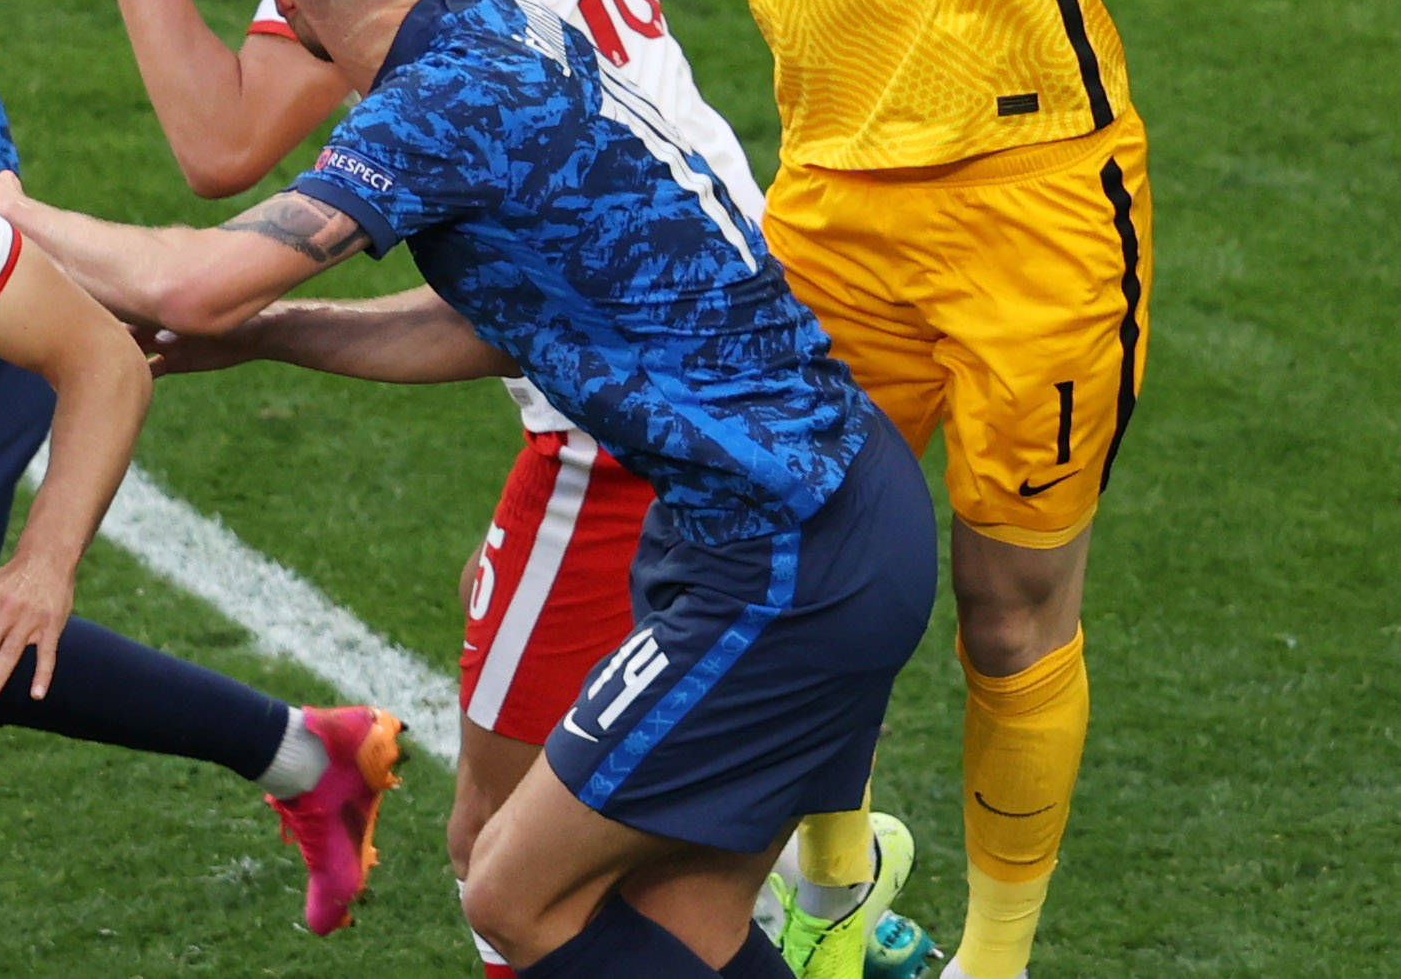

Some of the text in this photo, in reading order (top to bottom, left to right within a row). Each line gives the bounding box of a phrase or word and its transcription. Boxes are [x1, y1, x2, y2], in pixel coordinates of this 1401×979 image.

[328, 152, 393, 192] RESPECT
[1054, 381, 1074, 465] 1
[587, 627, 670, 731] 14
